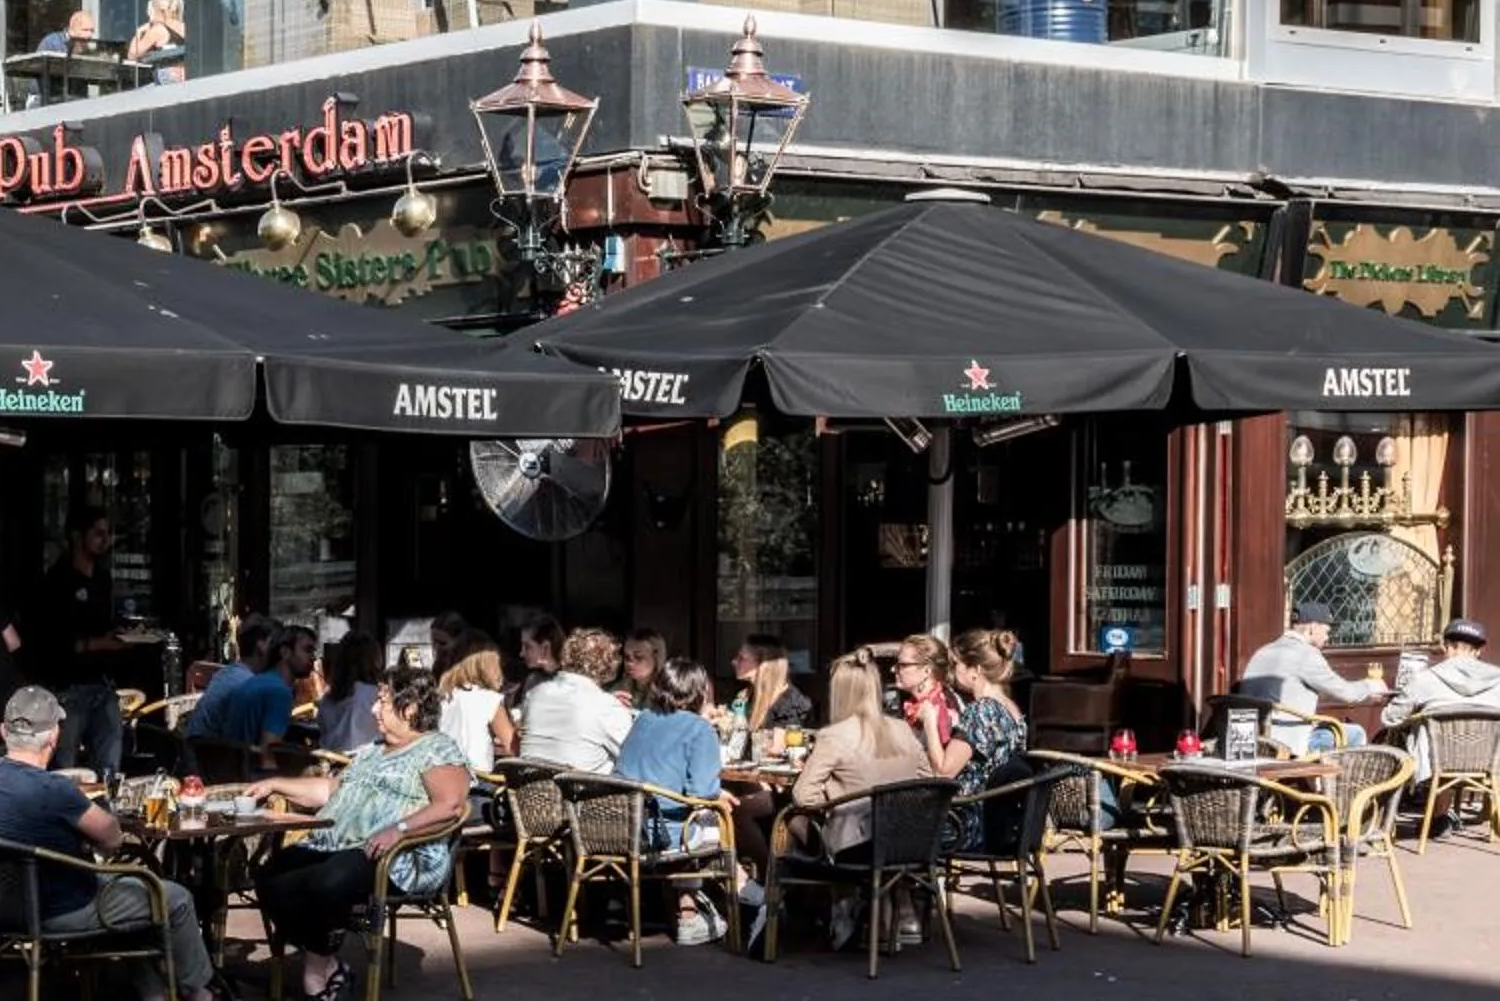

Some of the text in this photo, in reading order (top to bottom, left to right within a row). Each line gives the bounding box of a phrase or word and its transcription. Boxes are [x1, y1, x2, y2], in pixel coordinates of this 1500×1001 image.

[125, 95, 415, 197] Amsterdam
[424, 236, 493, 280] Pub
[1322, 367, 1412, 397] AMSTEL
[393, 383, 498, 420] AMSTEL
[943, 392, 1021, 412] Heineken
